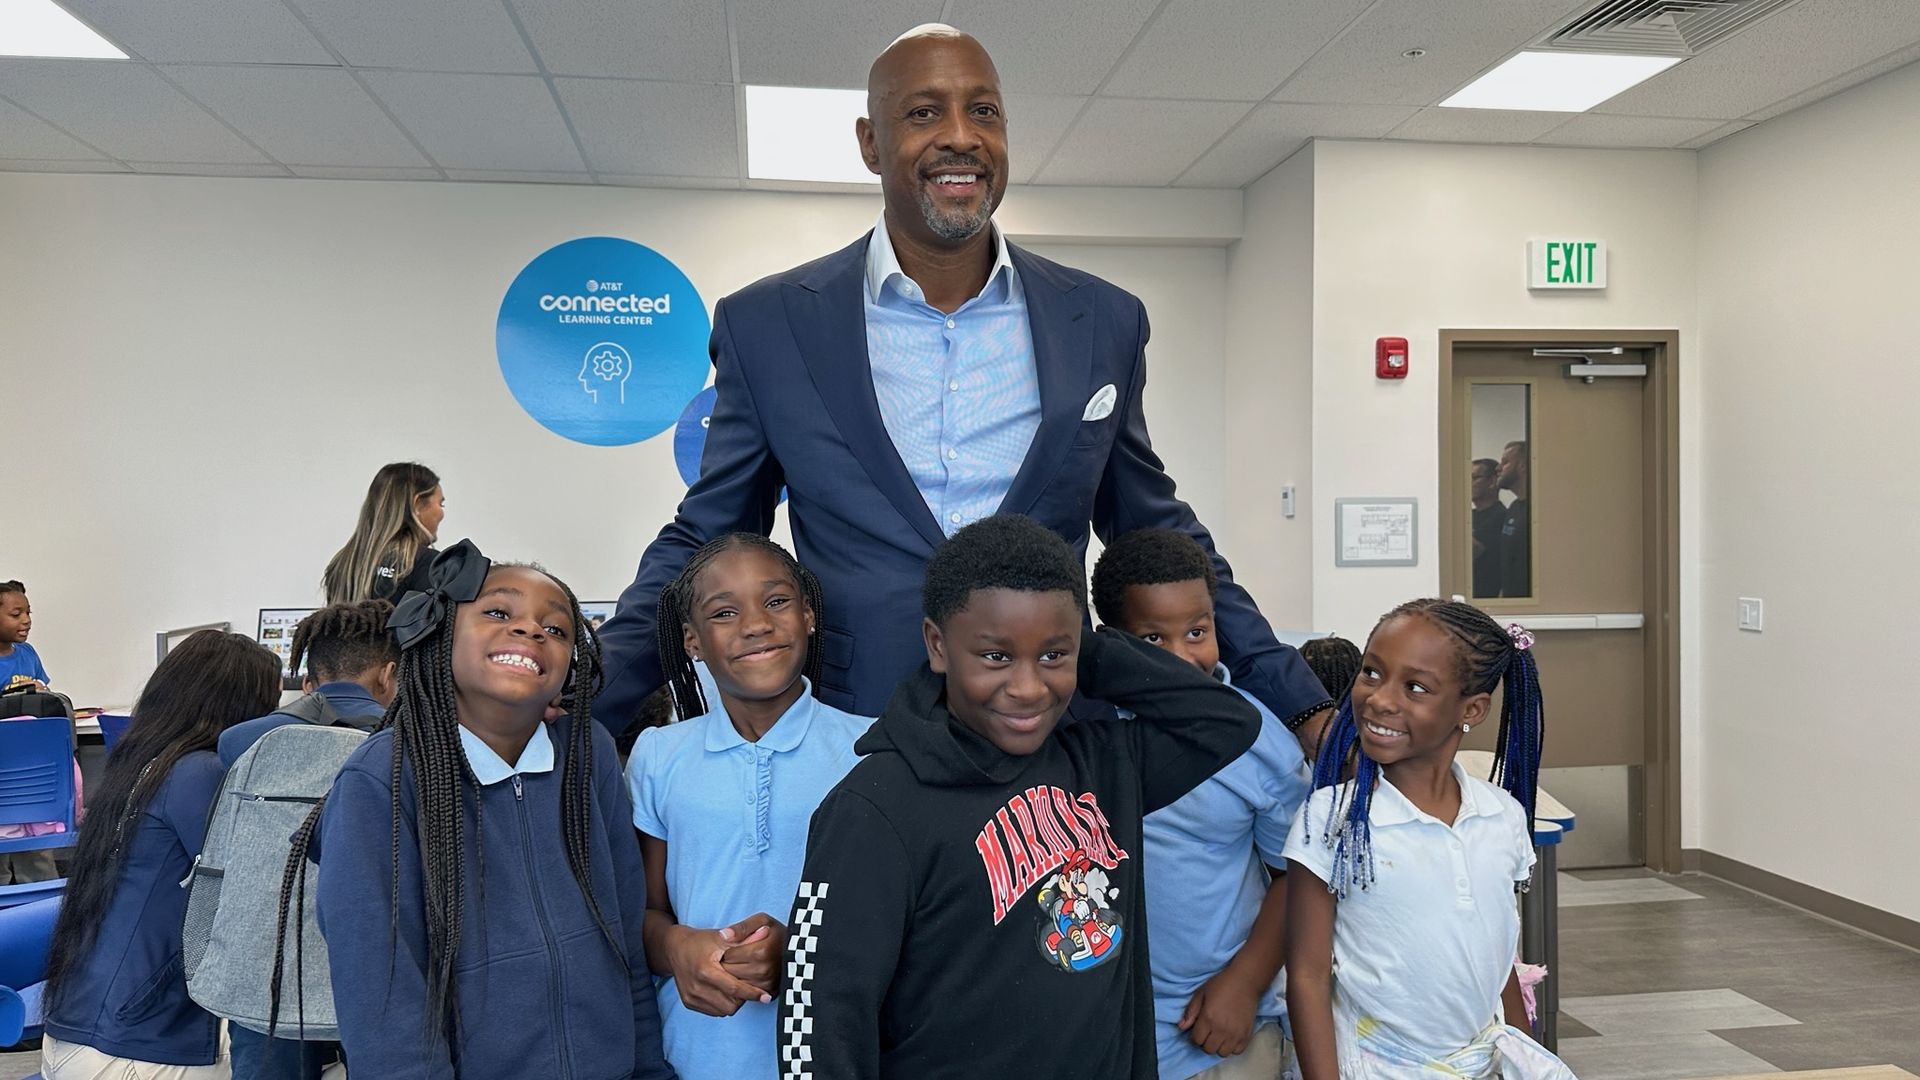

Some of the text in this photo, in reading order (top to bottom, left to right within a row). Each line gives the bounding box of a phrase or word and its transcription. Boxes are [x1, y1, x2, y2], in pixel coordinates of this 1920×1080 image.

[1547, 242, 1597, 283] EXIT
[600, 282, 623, 291] AT&T
[540, 293, 670, 314] connected
[559, 315, 653, 325] LEARNING CENTER
[975, 785, 1076, 926] MARIO
